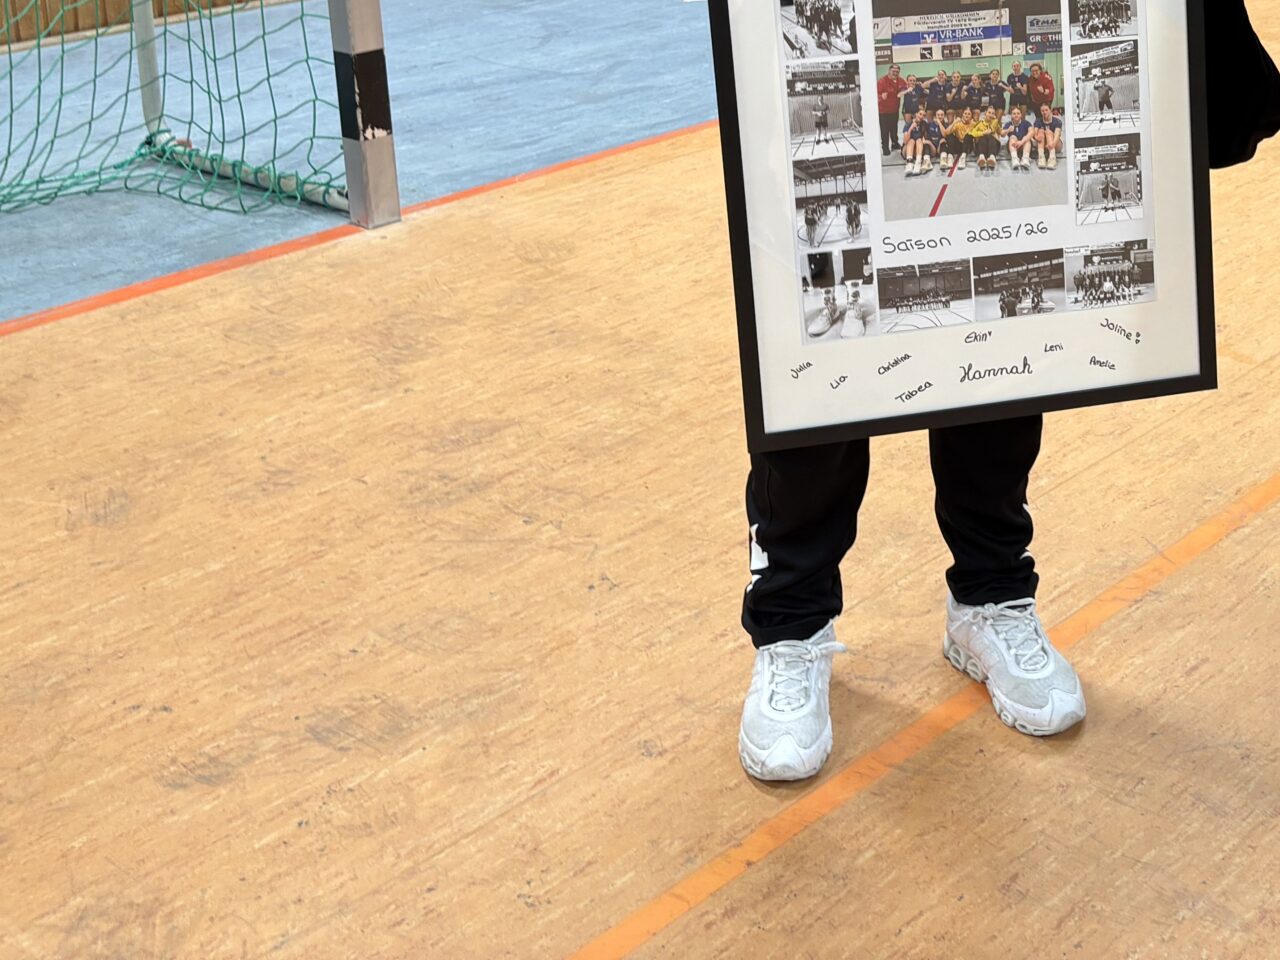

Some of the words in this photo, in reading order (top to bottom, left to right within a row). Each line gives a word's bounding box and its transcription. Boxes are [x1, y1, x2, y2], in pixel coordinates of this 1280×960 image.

[882, 236, 951, 254] Saison
[966, 221, 1048, 243] 2025/26
[1100, 317, 1132, 341] Joline
[1044, 342, 1064, 352] Leni
[790, 360, 813, 379] Julia
[877, 353, 912, 376] Christina
[959, 356, 1033, 383] Hannah
[1089, 355, 1116, 371] Amelie
[830, 375, 848, 390] Lia
[894, 380, 934, 404] Tabea
